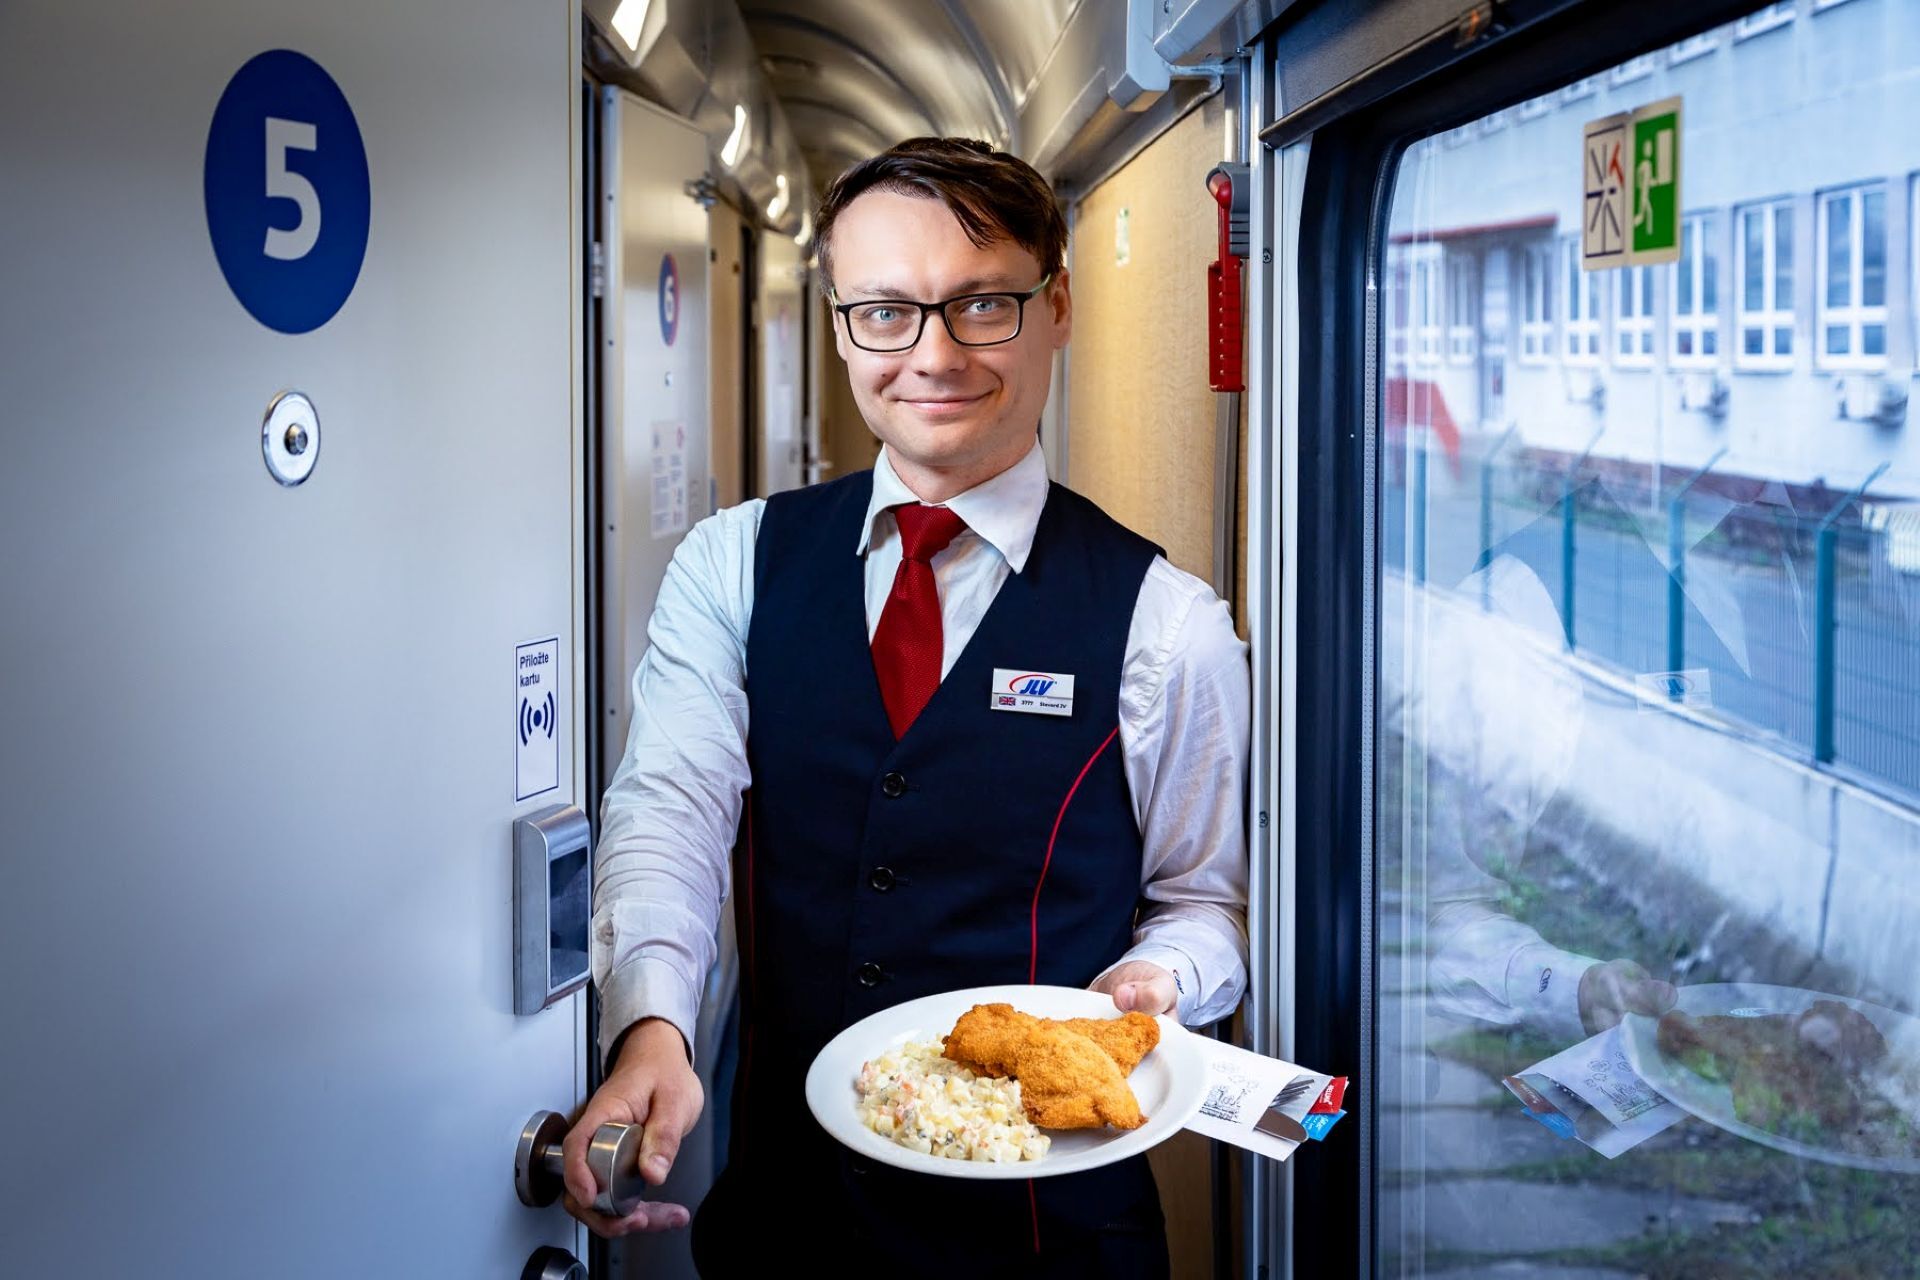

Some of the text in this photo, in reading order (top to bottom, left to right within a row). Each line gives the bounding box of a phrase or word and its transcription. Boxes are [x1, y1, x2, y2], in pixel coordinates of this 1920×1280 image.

[263, 116, 322, 261] 5
[664, 275, 674, 323] 6
[520, 652, 549, 669] Přiložte
[520, 673, 540, 687] kartu
[1019, 679, 1054, 695] JLV
